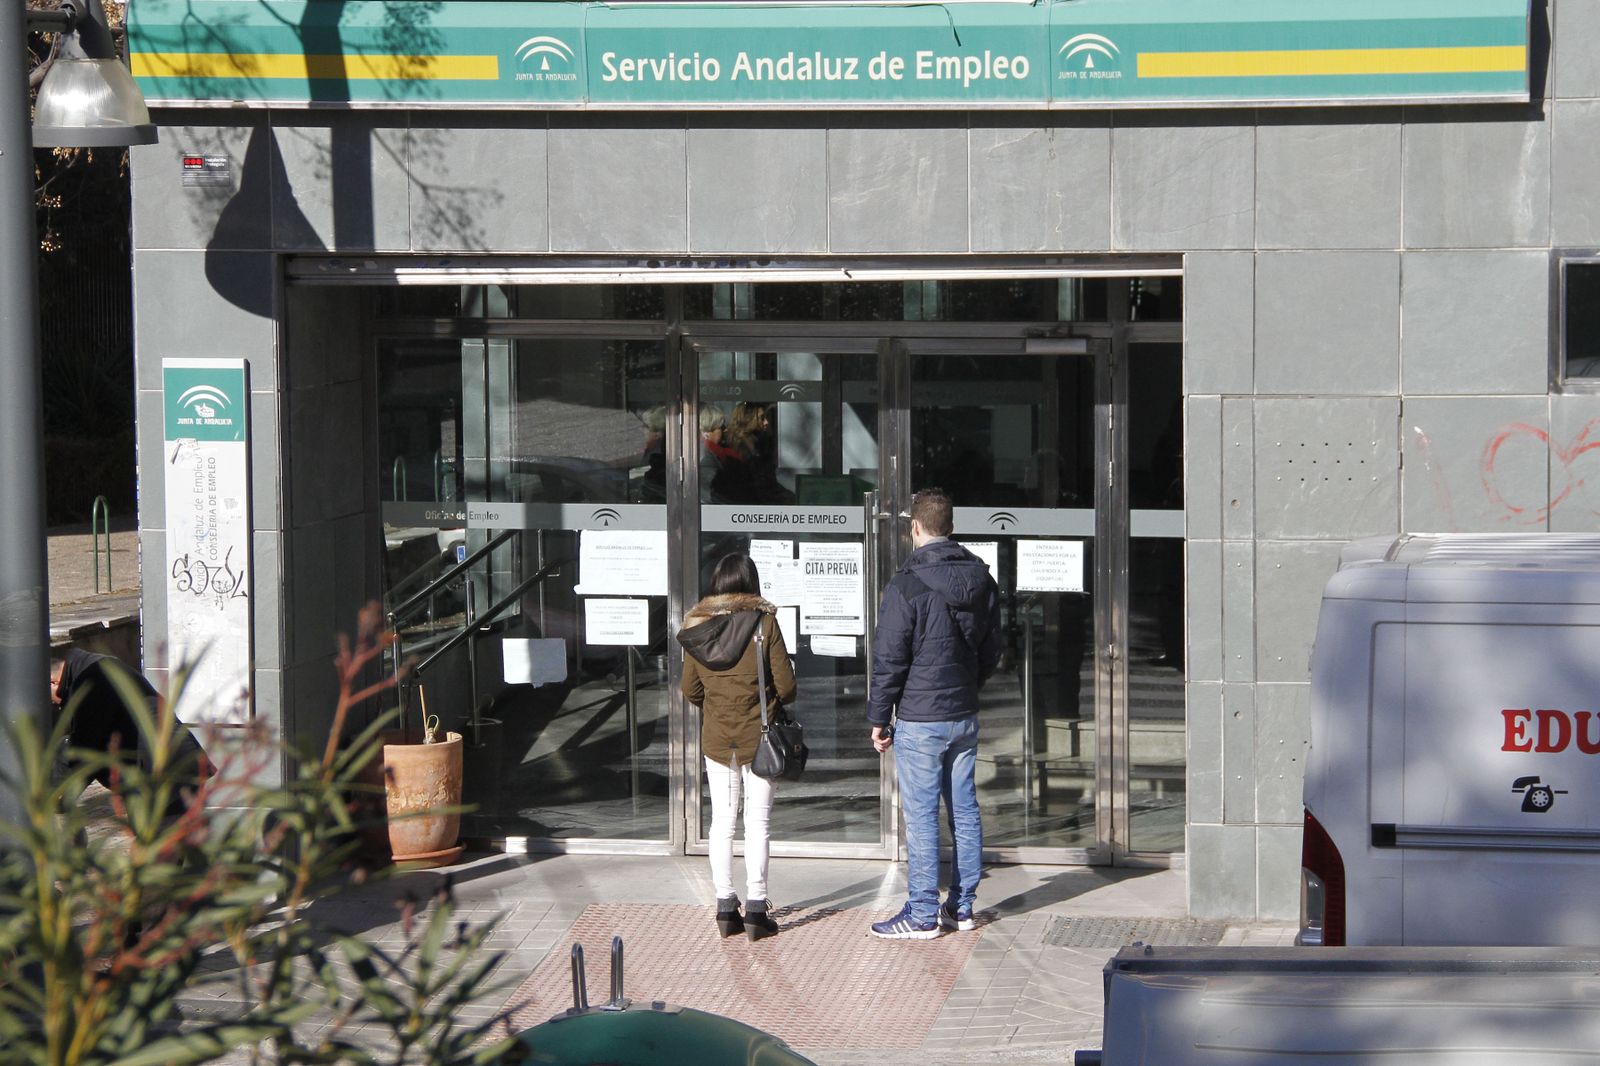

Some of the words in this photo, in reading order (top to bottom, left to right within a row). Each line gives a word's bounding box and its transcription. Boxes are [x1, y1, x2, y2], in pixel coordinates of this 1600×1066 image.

[601, 51, 721, 82] Servicio
[730, 51, 860, 82] Andaluz
[867, 50, 905, 81] de
[915, 50, 1030, 88] Empleo
[1058, 71, 1078, 80] JUNTA
[1079, 71, 1088, 80] DE
[515, 73, 534, 81] JUNTA
[535, 73, 543, 81] DE
[177, 417, 194, 425] JUNTA
[195, 417, 203, 425] DE
[207, 456, 217, 492] EMPLEO
[194, 497, 204, 511] de
[208, 494, 217, 507] DE
[456, 510, 466, 520] de
[468, 510, 500, 523] Empleo
[731, 511, 790, 524] CONSEJERÍA
[792, 514, 805, 524] DE
[808, 514, 847, 525] EMPLEO
[805, 562, 825, 575] CITA
[827, 562, 859, 576] PREVIA
[1500, 708, 1600, 755] EDU
